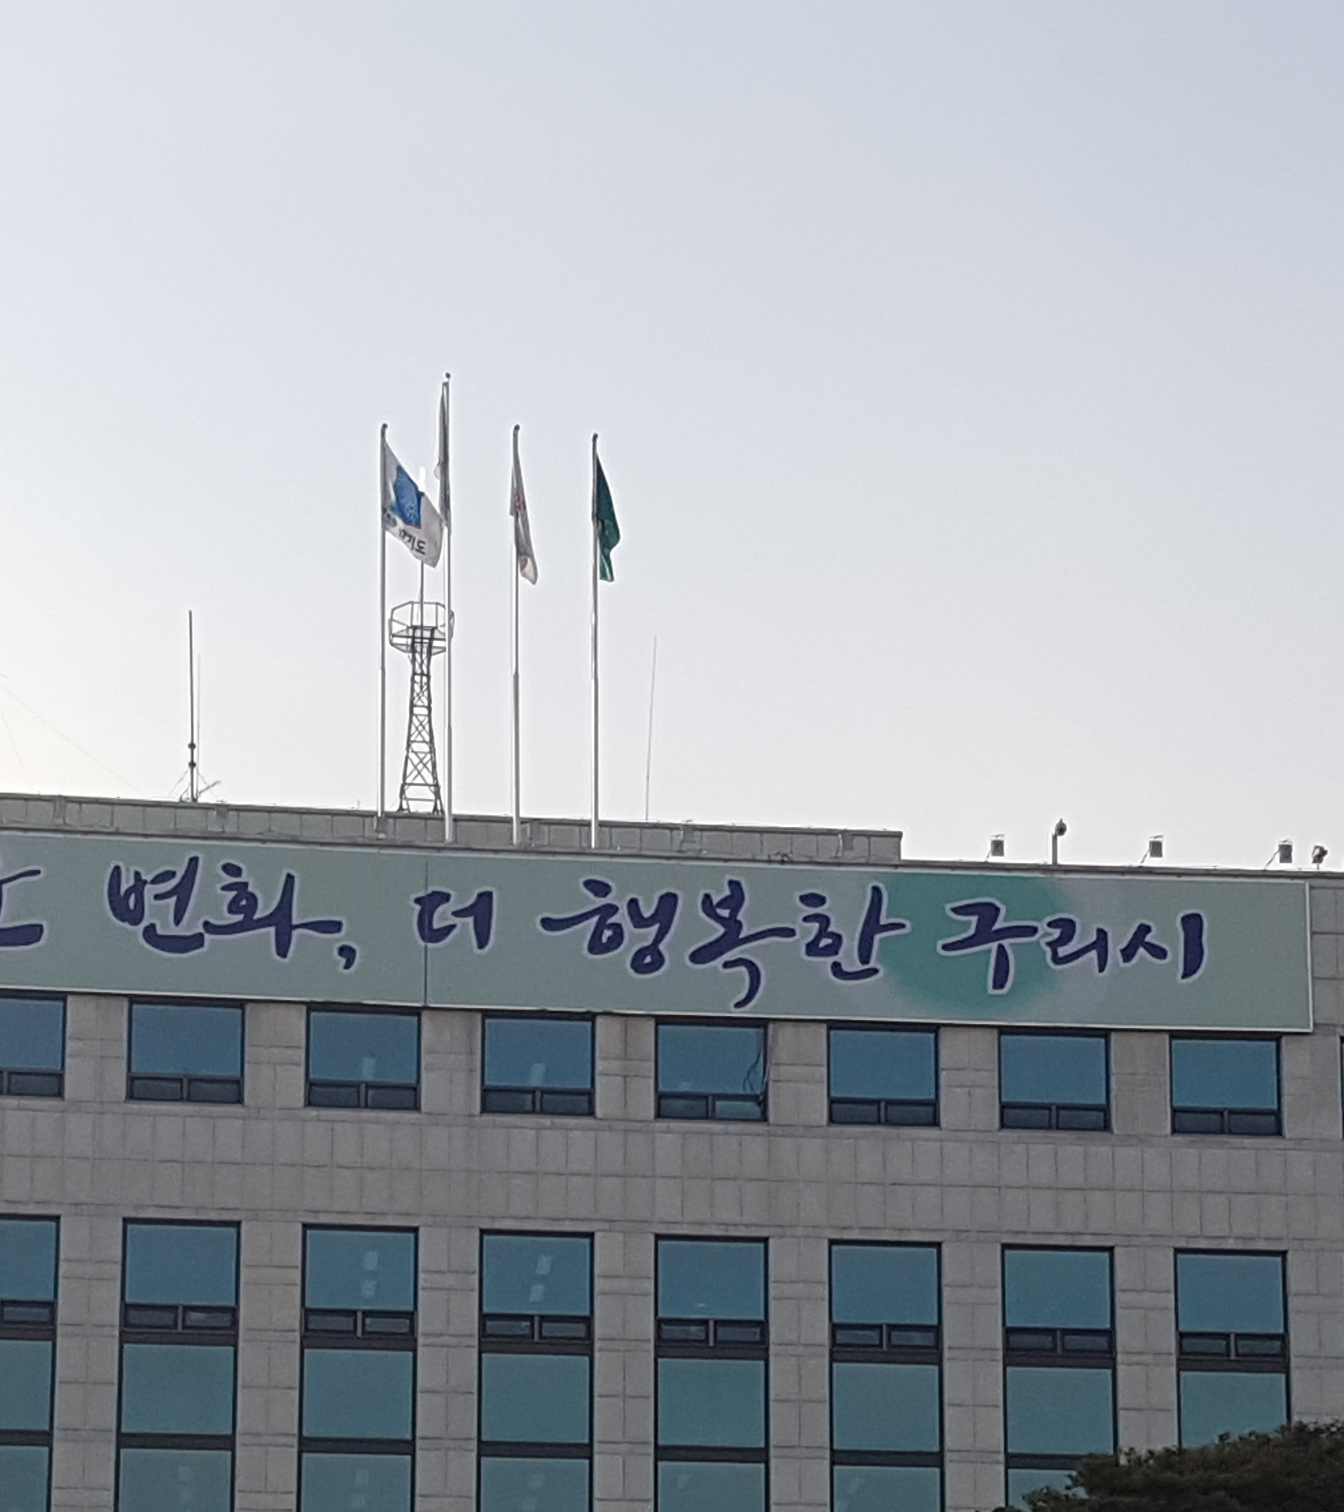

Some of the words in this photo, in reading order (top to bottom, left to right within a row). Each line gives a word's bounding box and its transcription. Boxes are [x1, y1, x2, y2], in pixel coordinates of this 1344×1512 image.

[107, 855, 359, 971] 변화,
[414, 887, 497, 953] 더
[539, 877, 909, 1010] 행복한
[938, 899, 1204, 993] 구리시
